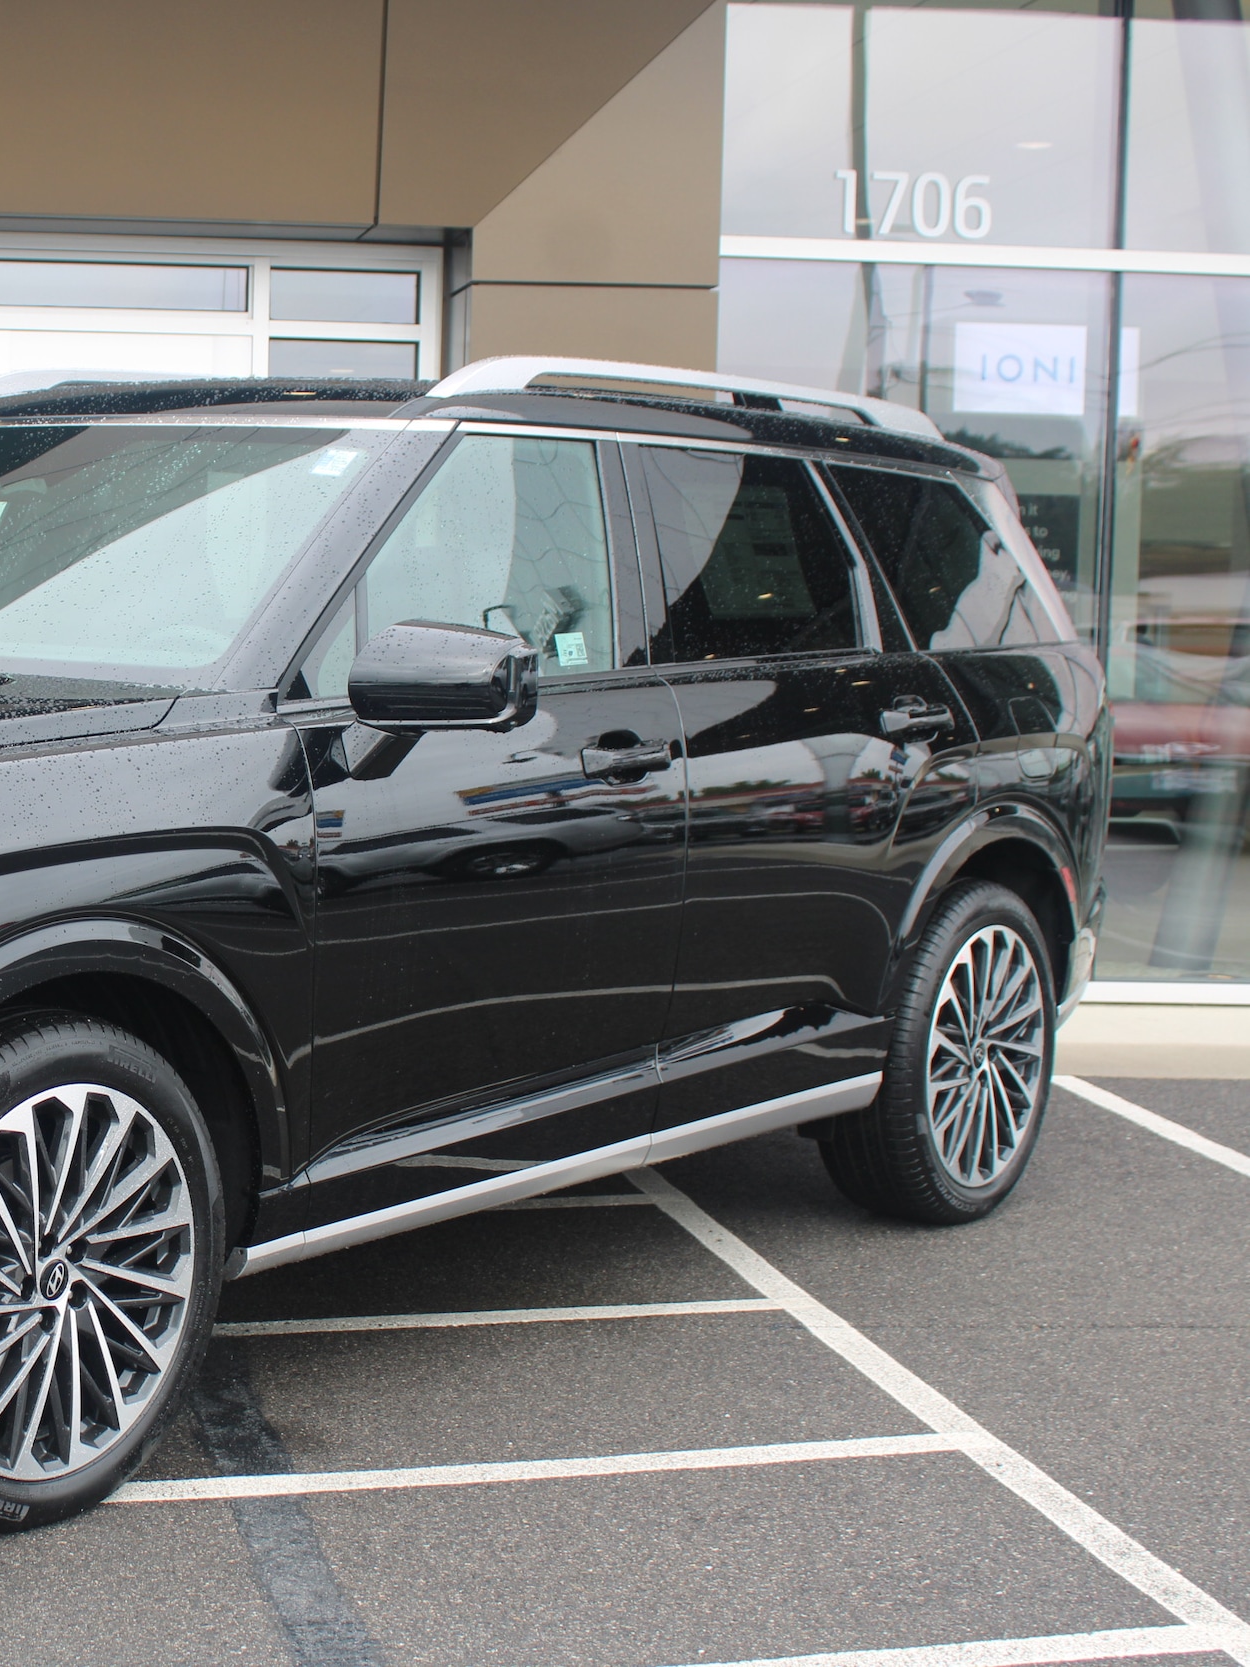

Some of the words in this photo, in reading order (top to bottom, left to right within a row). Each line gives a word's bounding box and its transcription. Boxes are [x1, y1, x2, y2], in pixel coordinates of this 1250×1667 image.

[834, 169, 992, 239] 1706
[981, 353, 1077, 384] IONI
[1033, 526, 1048, 538] to
